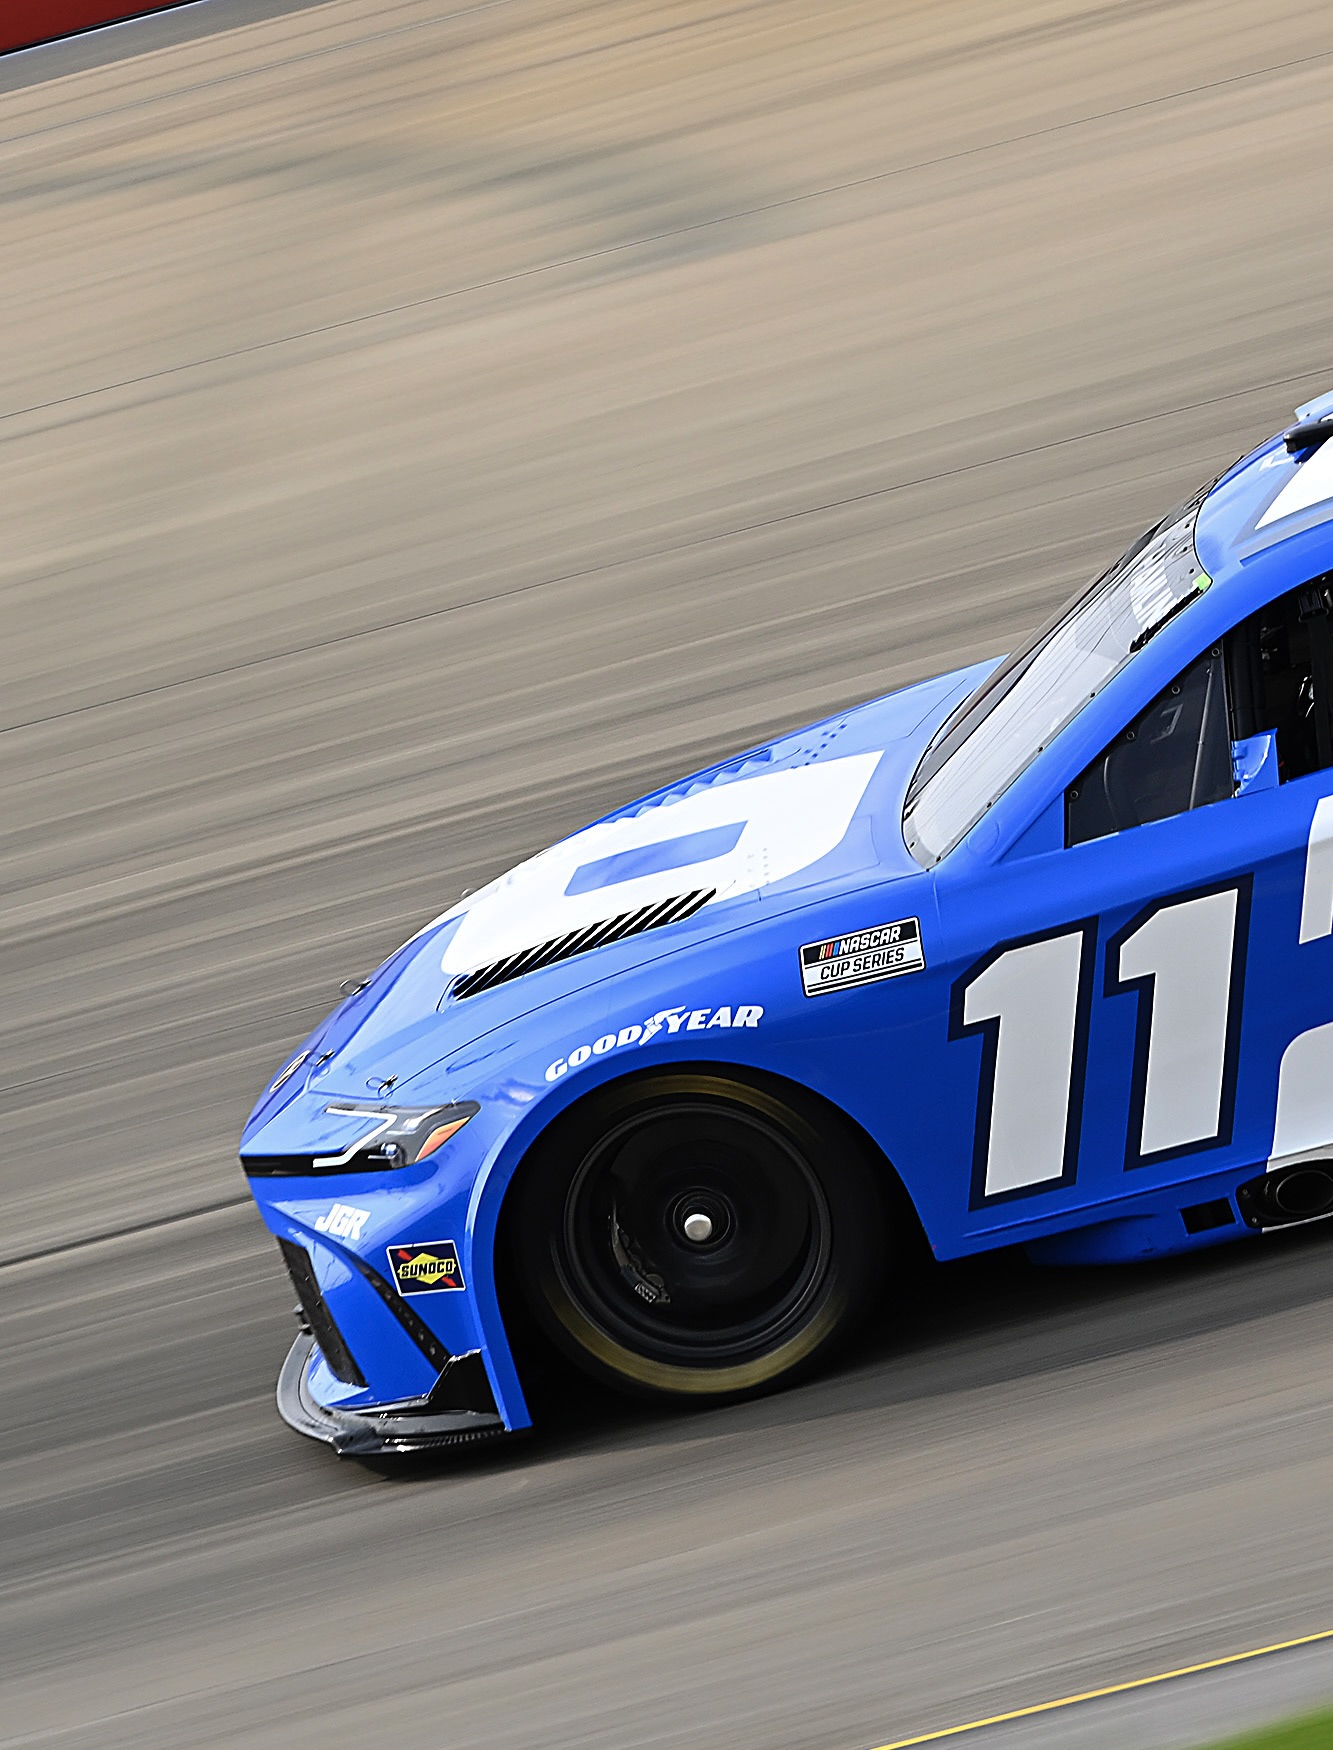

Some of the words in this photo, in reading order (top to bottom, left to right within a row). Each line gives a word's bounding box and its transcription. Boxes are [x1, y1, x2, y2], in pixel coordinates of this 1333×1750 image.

[838, 925, 902, 956] NASCAR
[820, 960, 850, 980] CUP
[852, 947, 905, 973] SERIES
[545, 1004, 764, 1083] GOODYEAR
[962, 884, 1238, 1197] 11
[314, 1203, 371, 1240] JGR
[401, 1261, 453, 1279] SUNOCO
